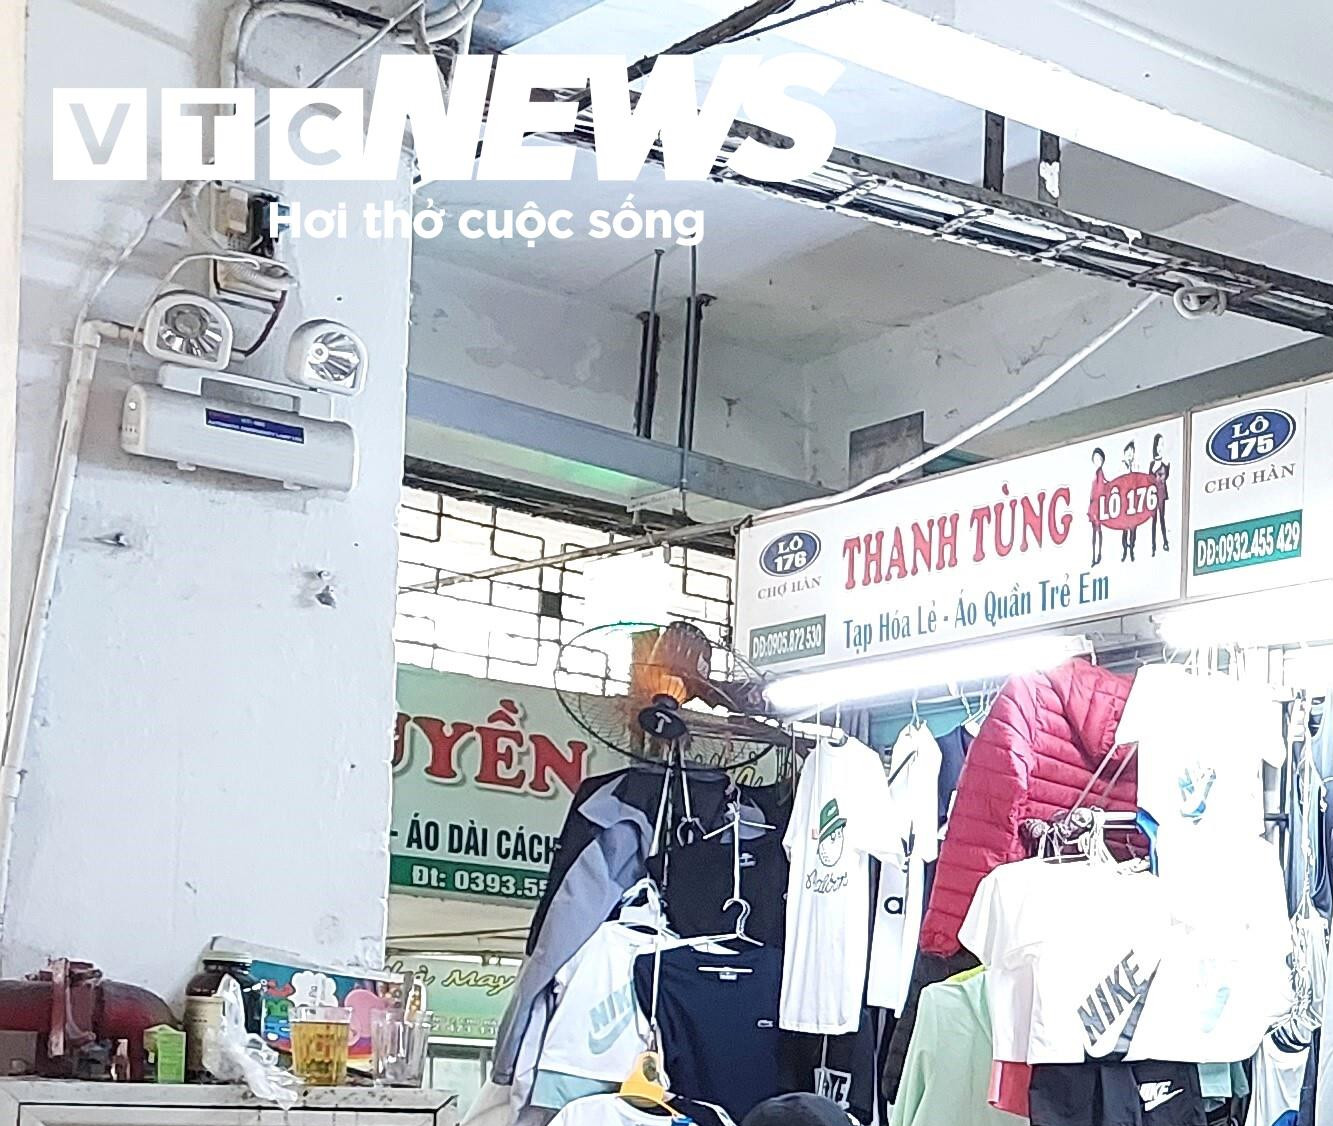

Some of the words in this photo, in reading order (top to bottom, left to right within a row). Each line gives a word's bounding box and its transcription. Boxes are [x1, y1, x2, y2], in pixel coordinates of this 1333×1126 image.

[1231, 413, 1271, 440] LÔ
[1226, 433, 1275, 463] 175
[1203, 469, 1247, 498] CHỢ
[1250, 461, 1296, 488] HÀN
[1097, 484, 1123, 520] LÔ
[1125, 482, 1158, 518] 176
[777, 535, 804, 555] LÔ
[841, 512, 960, 592] THANH
[970, 483, 1073, 564] TÙNG
[1276, 521, 1301, 553] 429
[773, 550, 807, 573] 176
[842, 618, 873, 653] Tạp
[879, 607, 911, 642] Hóa
[955, 587, 978, 628] Áo
[983, 582, 1032, 627] Quần
[1079, 570, 1109, 606] Em
[405, 812, 440, 851] ÁO
[447, 819, 488, 857] DÀI
[411, 864, 447, 888] Đt:
[441, 969, 517, 997] May
[1077, 948, 1148, 1047] NIKE
